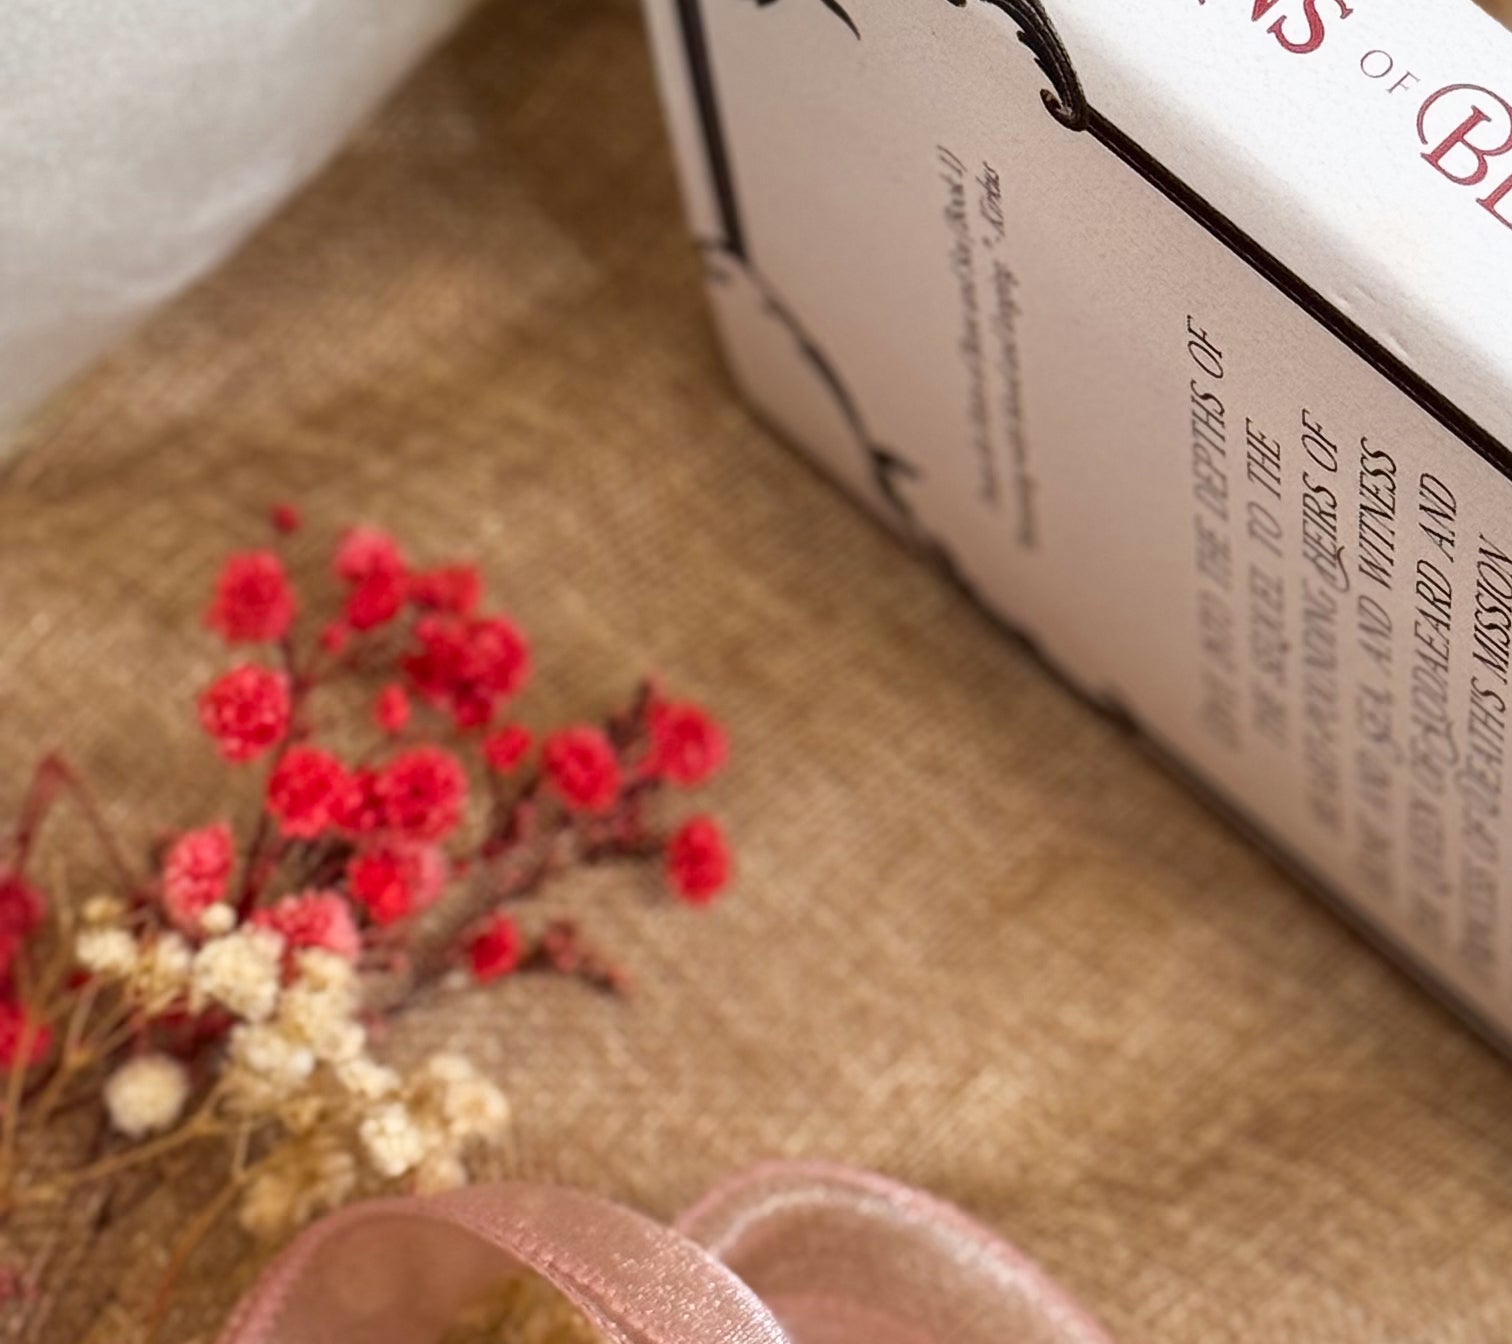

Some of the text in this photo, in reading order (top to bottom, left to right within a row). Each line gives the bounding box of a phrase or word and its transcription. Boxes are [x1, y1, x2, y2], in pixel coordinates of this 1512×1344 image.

[1360, 50, 1421, 96] OF
[1186, 313, 1223, 379] OF
[1245, 416, 1281, 499] THE
[1301, 408, 1338, 472] OF
[1246, 501, 1283, 557] TO
[1301, 471, 1350, 592] HEIRS
[1359, 436, 1398, 590] WITNESS
[1419, 472, 1457, 561] AND
[1358, 593, 1394, 668] AND
